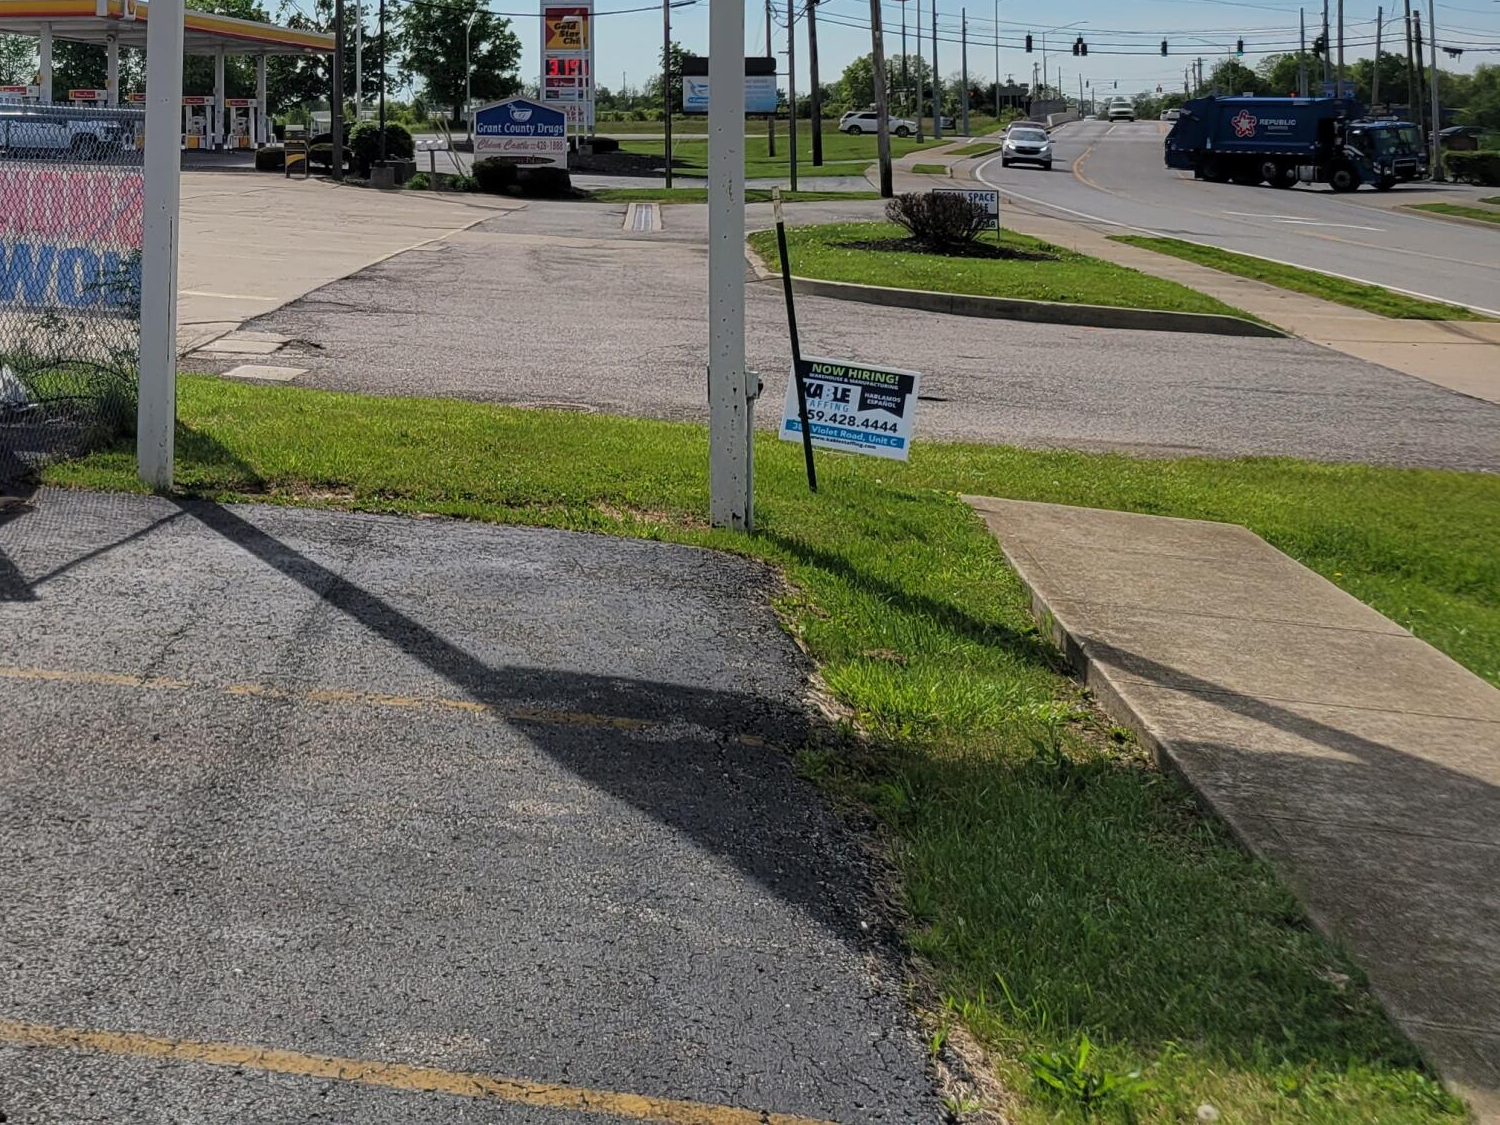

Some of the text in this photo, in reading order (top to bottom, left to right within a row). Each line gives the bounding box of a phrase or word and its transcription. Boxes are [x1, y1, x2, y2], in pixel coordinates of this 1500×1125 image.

[1259, 118, 1296, 126] REPUBLIC
[477, 122, 564, 136] Grant County Drugs
[968, 192, 995, 202] SPACE
[812, 363, 899, 385] NOW HIRING!
[864, 392, 901, 403] HABLAMOS
[812, 425, 838, 437] Violet
[868, 435, 888, 445] Unit
[890, 437, 898, 446] C
